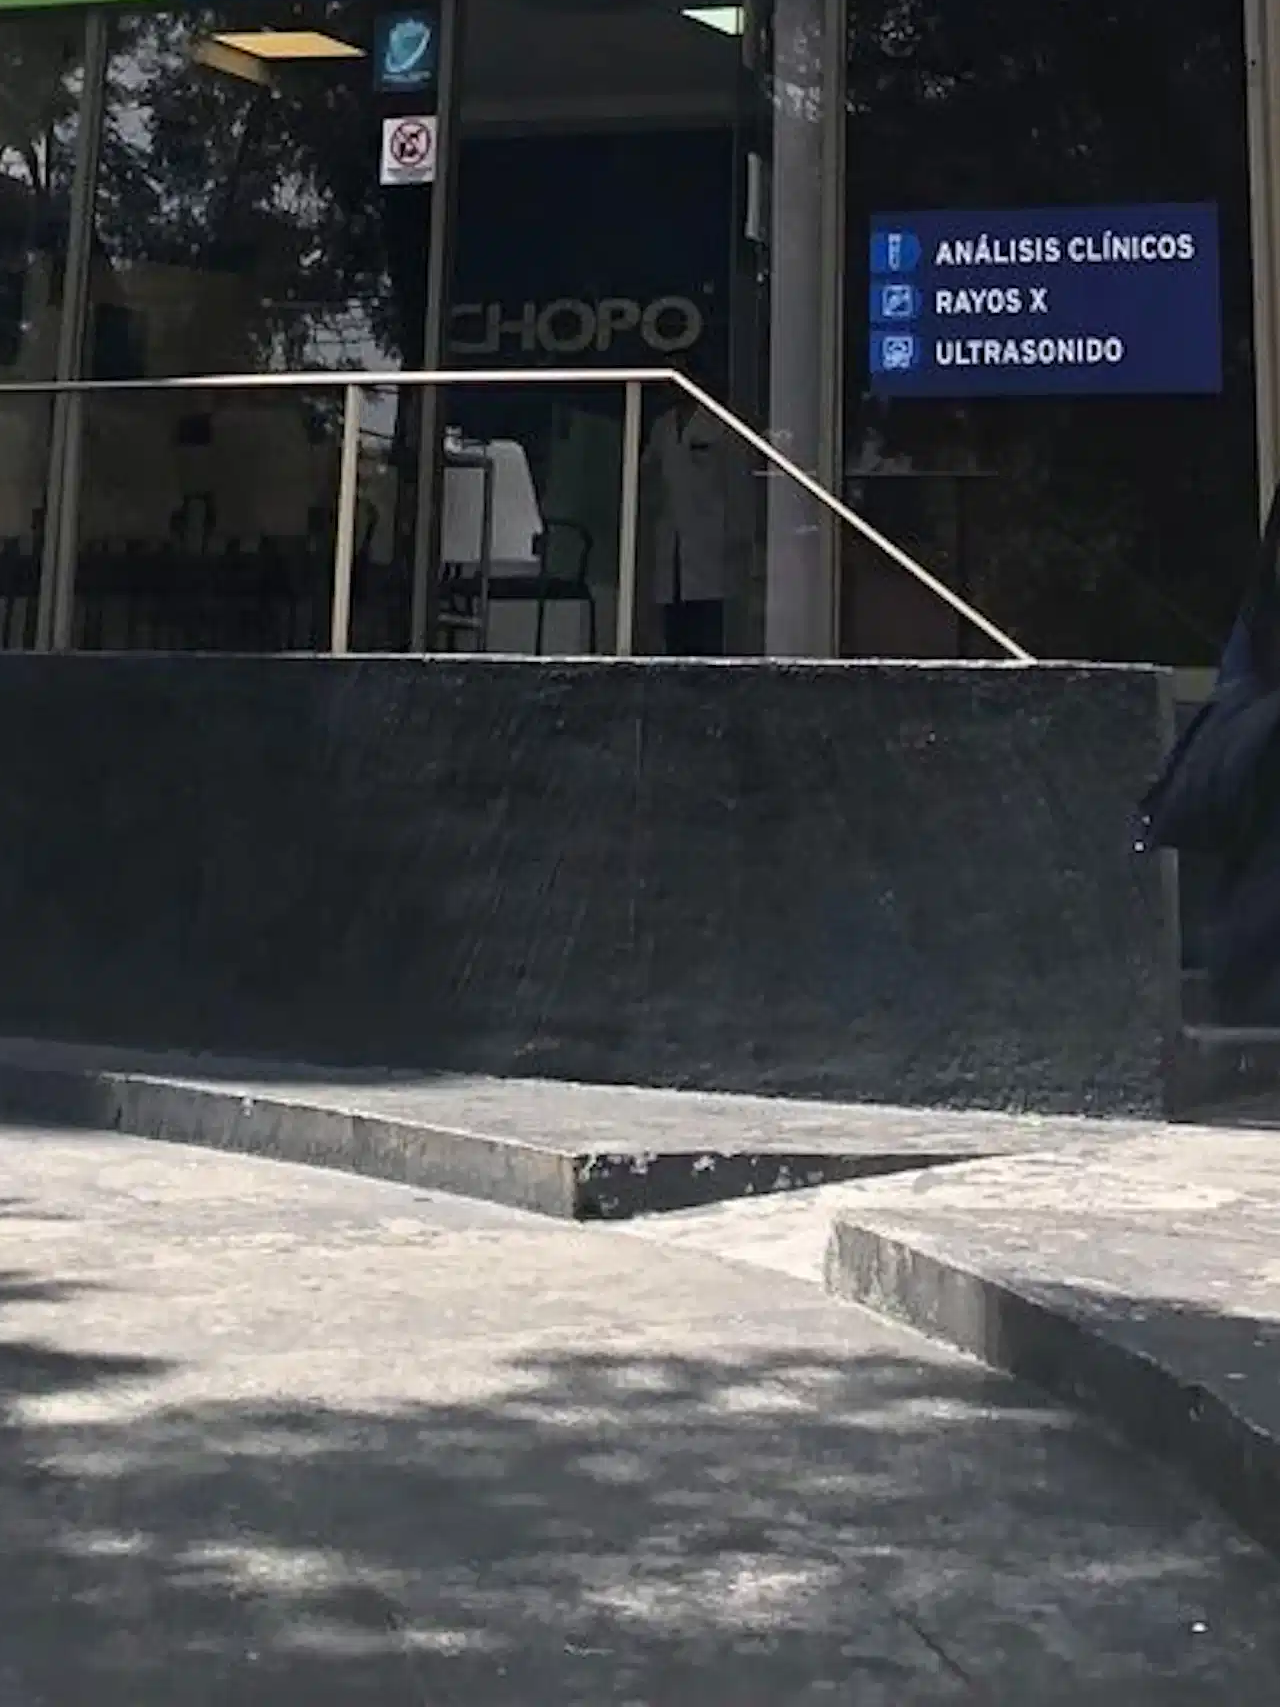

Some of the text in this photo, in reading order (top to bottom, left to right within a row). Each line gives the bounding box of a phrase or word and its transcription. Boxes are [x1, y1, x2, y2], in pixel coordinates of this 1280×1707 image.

[935, 230, 1195, 266] ANÁLISIS CLÍNICOS
[935, 287, 1048, 314] RAYOS X
[935, 337, 1123, 365] ULTRASONIDO
